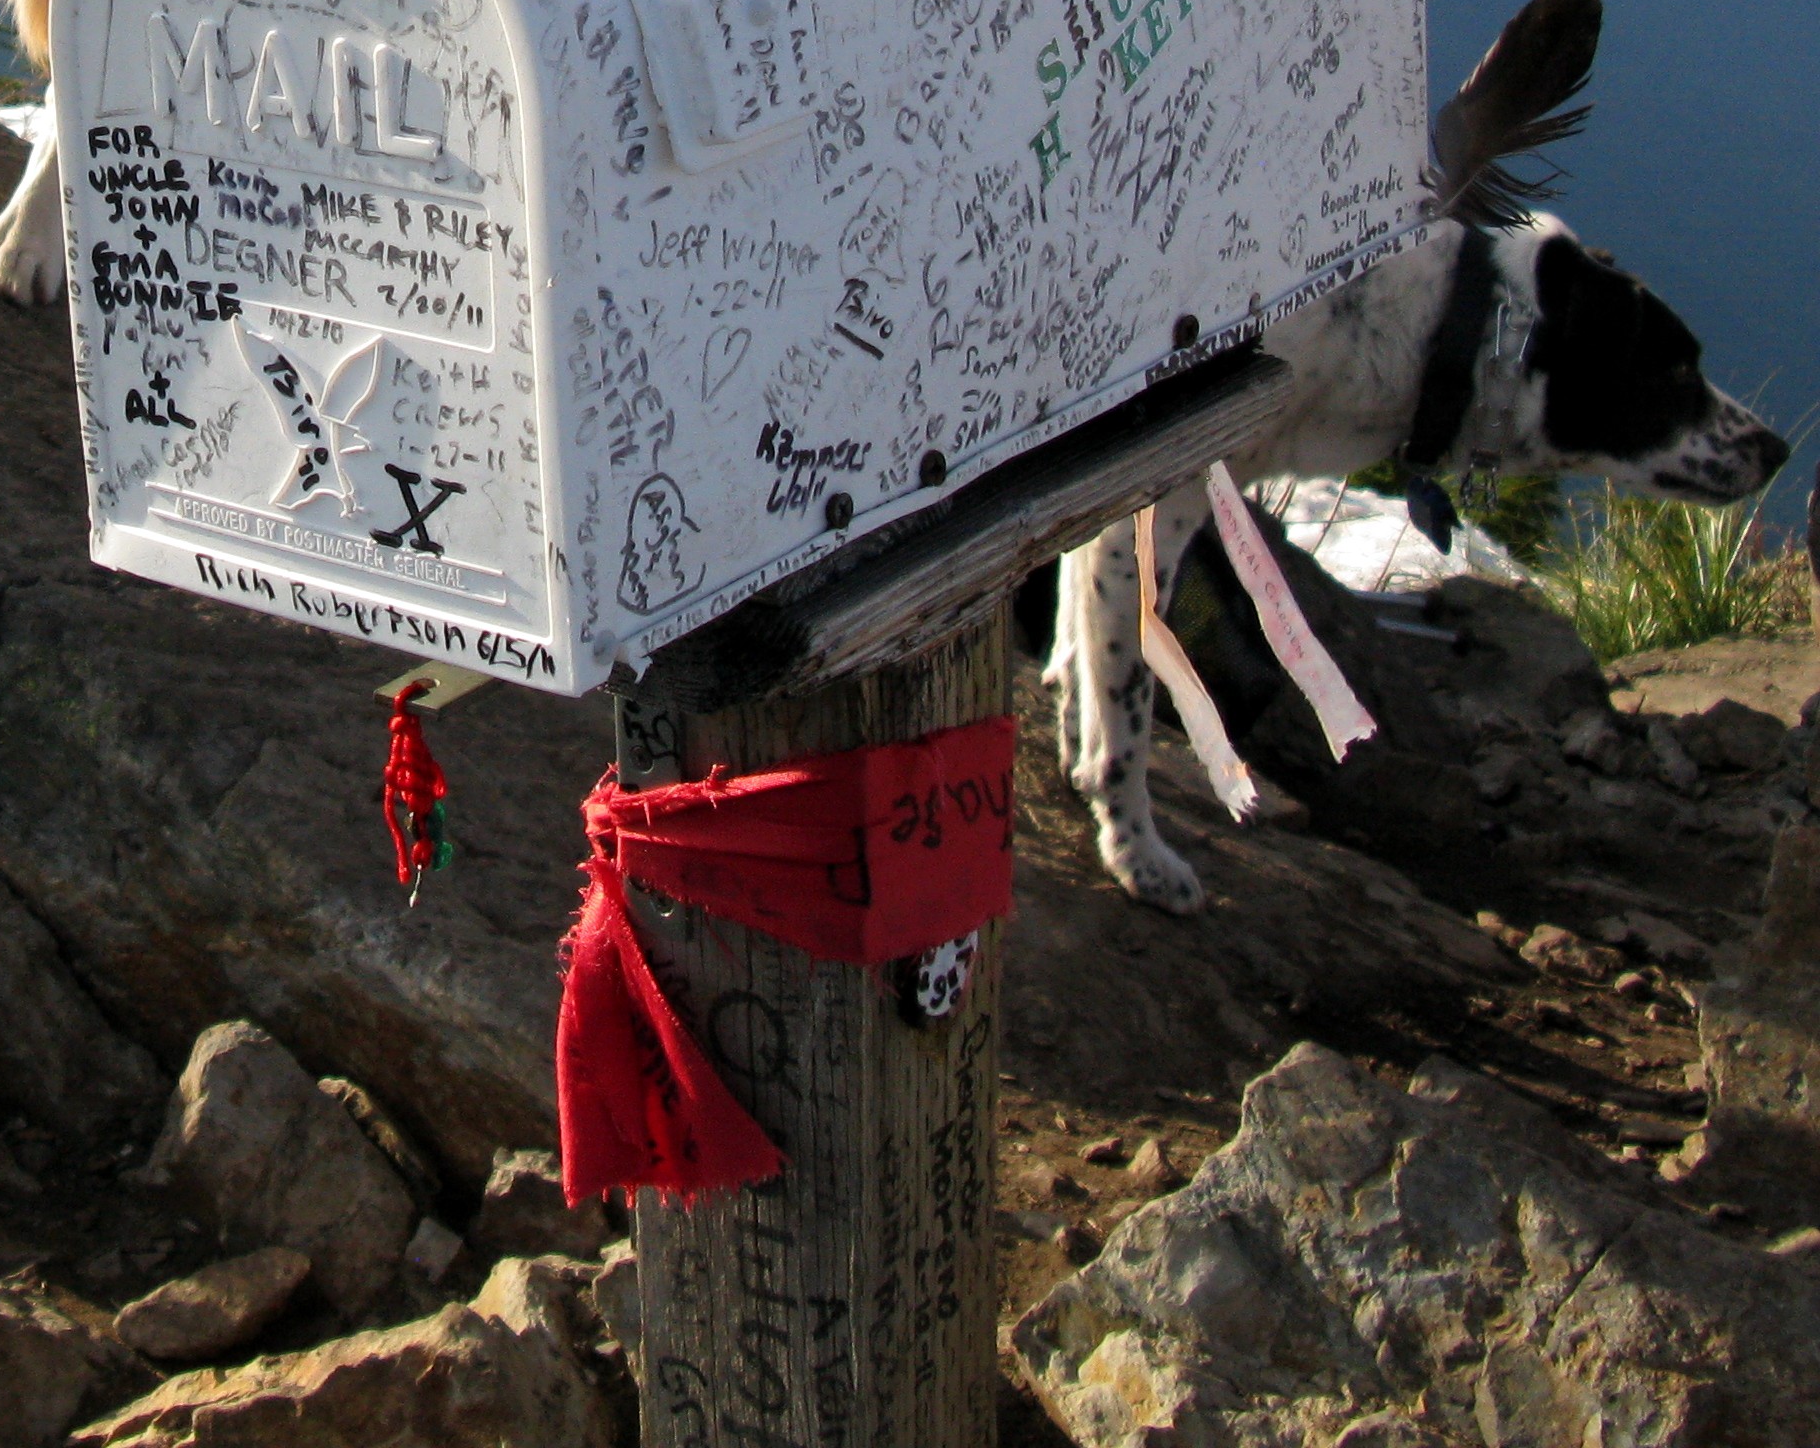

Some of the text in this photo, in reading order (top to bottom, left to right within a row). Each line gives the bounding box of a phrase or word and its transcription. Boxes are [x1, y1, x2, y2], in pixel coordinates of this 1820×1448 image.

[145, 8, 444, 158] MAIL
[87, 124, 162, 159] FOR
[87, 158, 191, 194] UNCLE
[104, 191, 201, 227] JOHN
[299, 181, 383, 227] MIKE
[423, 203, 515, 259] RILEY
[132, 222, 158, 252] +
[638, 219, 711, 270] Jeff
[91, 240, 180, 285] GMA
[184, 220, 358, 309] DEGNER
[92, 275, 244, 322] BONNIE
[148, 370, 171, 400] +
[124, 388, 198, 431] ALL
[367, 461, 468, 559] X
[173, 496, 467, 591] APPROVED BY POSTMASTER GENERAL
[194, 552, 276, 600] Rich
[289, 581, 468, 650] Robertson
